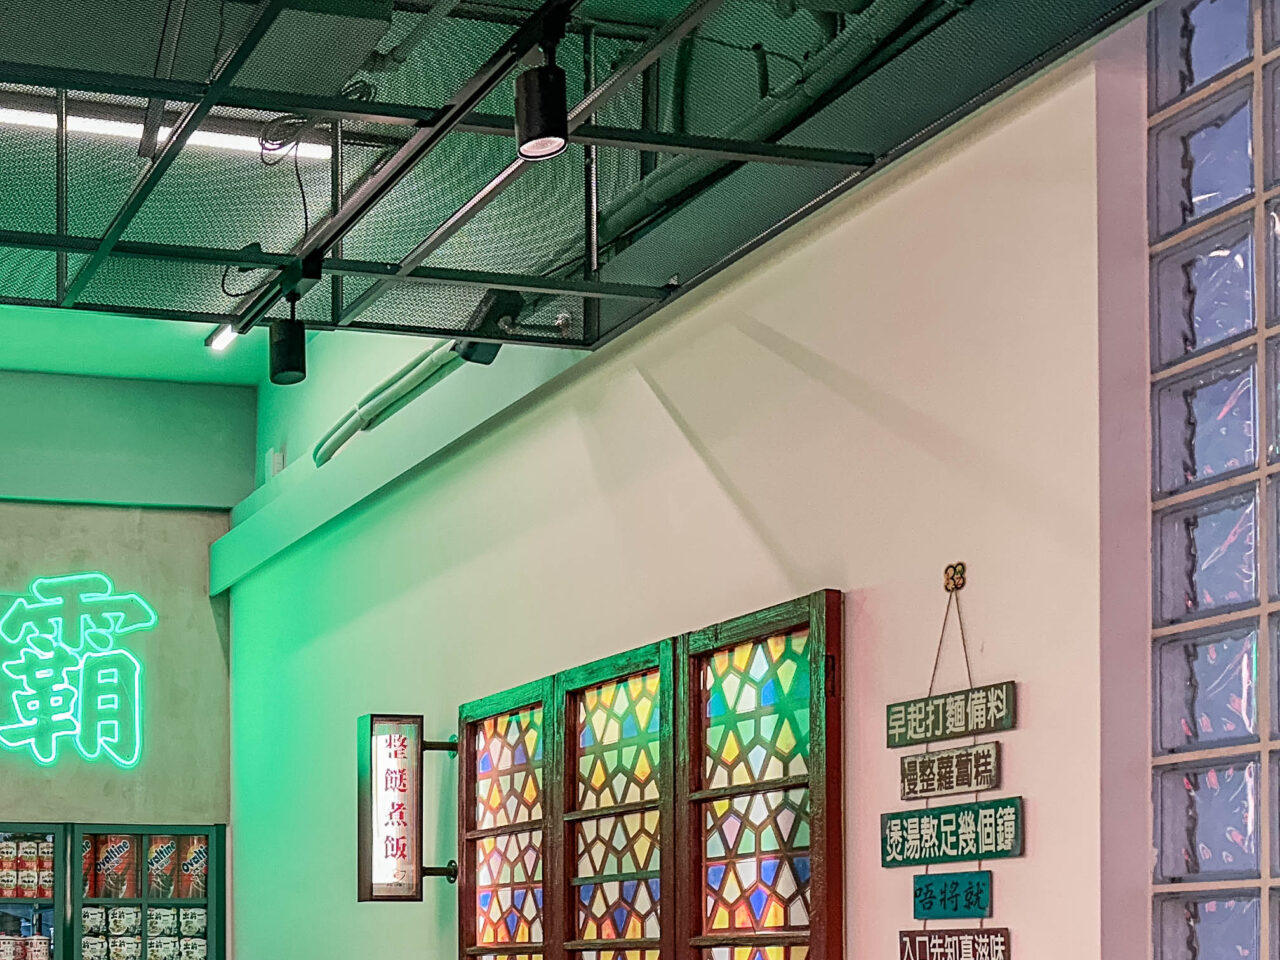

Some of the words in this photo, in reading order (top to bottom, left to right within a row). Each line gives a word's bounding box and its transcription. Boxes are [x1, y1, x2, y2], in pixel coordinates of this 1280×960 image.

[887, 684, 1008, 743] 早起打麵備料
[885, 804, 1017, 863] 煲湯熬足幾個鐘
[96, 840, 129, 872] Ovaltine
[148, 841, 176, 871] valtine
[914, 881, 988, 913] 唔將就
